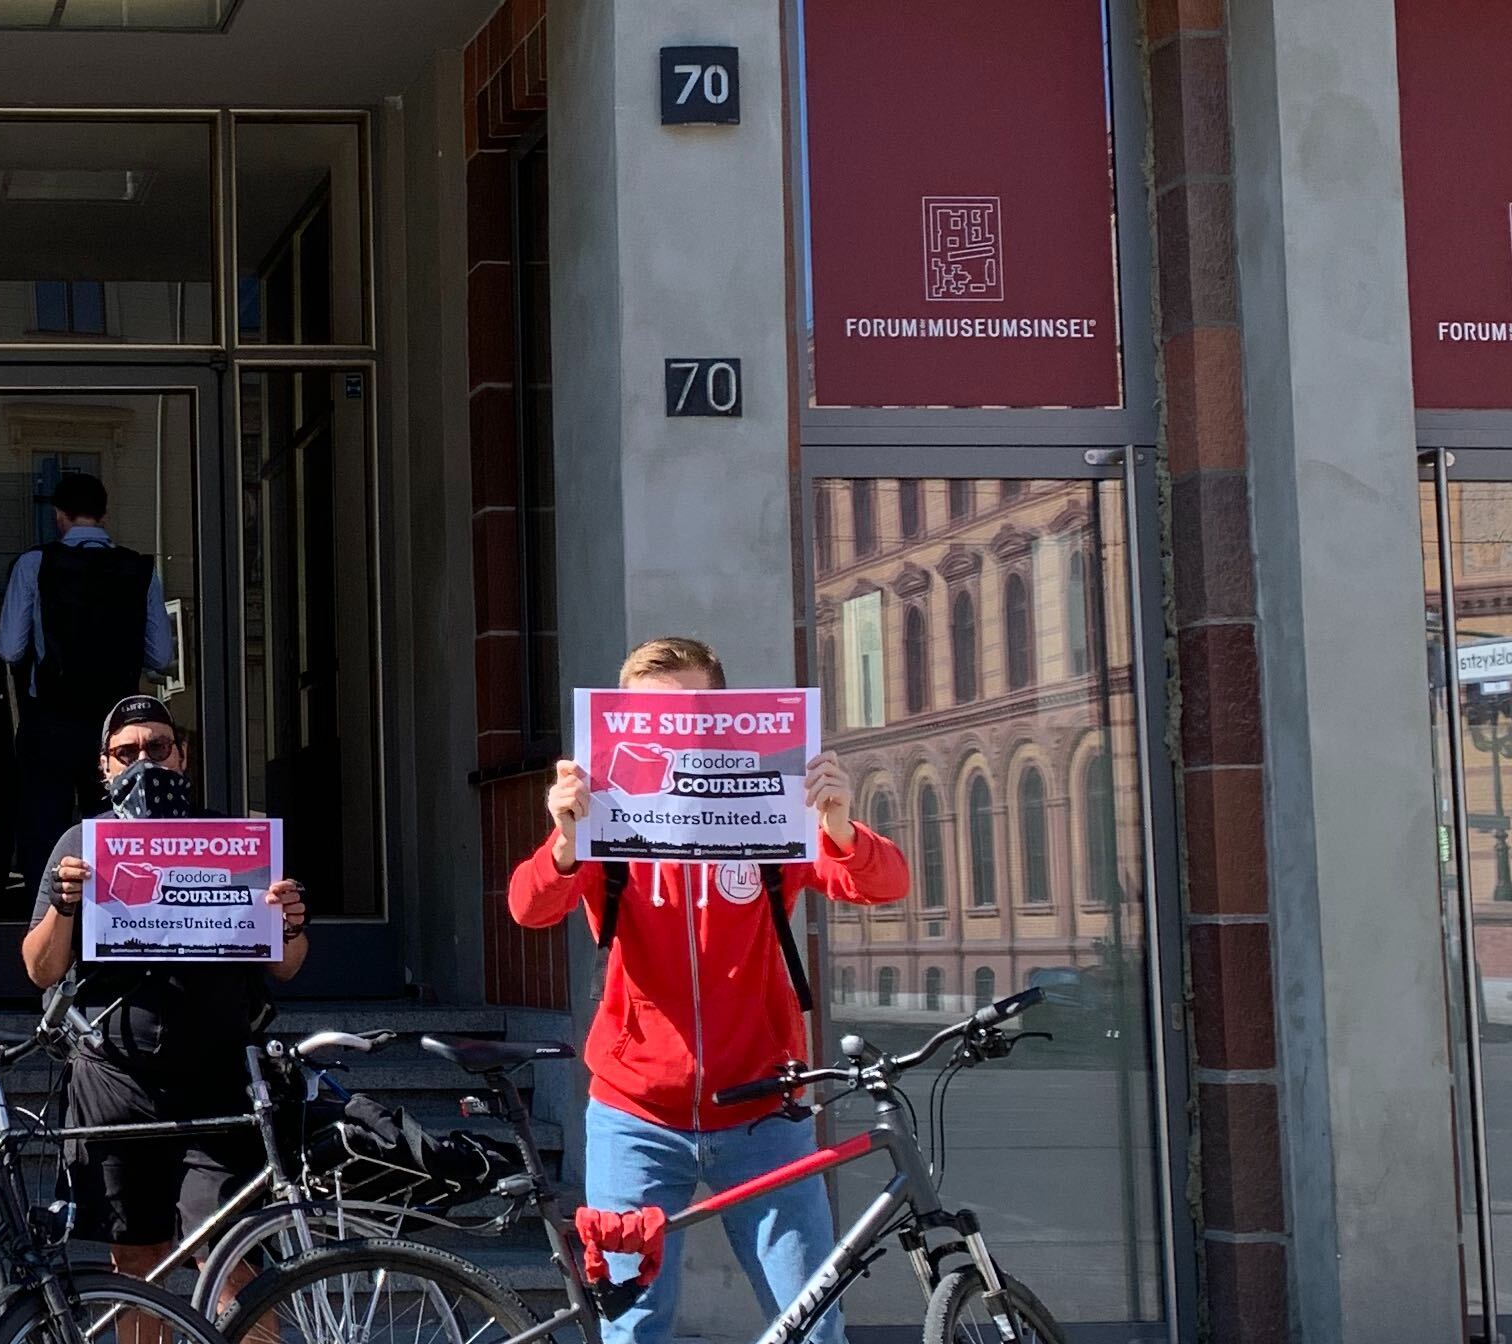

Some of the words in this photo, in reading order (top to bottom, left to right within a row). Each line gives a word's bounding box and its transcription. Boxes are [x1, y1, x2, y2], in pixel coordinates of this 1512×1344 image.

[674, 64, 729, 104] 70
[846, 318, 918, 338] FORUM
[1438, 322, 1507, 341] FORUM
[670, 362, 736, 411] 70
[602, 712, 651, 734] WE
[659, 712, 794, 735] SUPPORT
[681, 754, 755, 769] foodora
[677, 777, 781, 793] COURIERS
[610, 809, 787, 826] FoodstersUnited.ca
[105, 837, 144, 856] WE
[150, 837, 261, 856] SUPPORT
[169, 870, 227, 883] foodora
[165, 890, 249, 903] COURIERS
[112, 917, 255, 929] FoodstersUnited.ca
